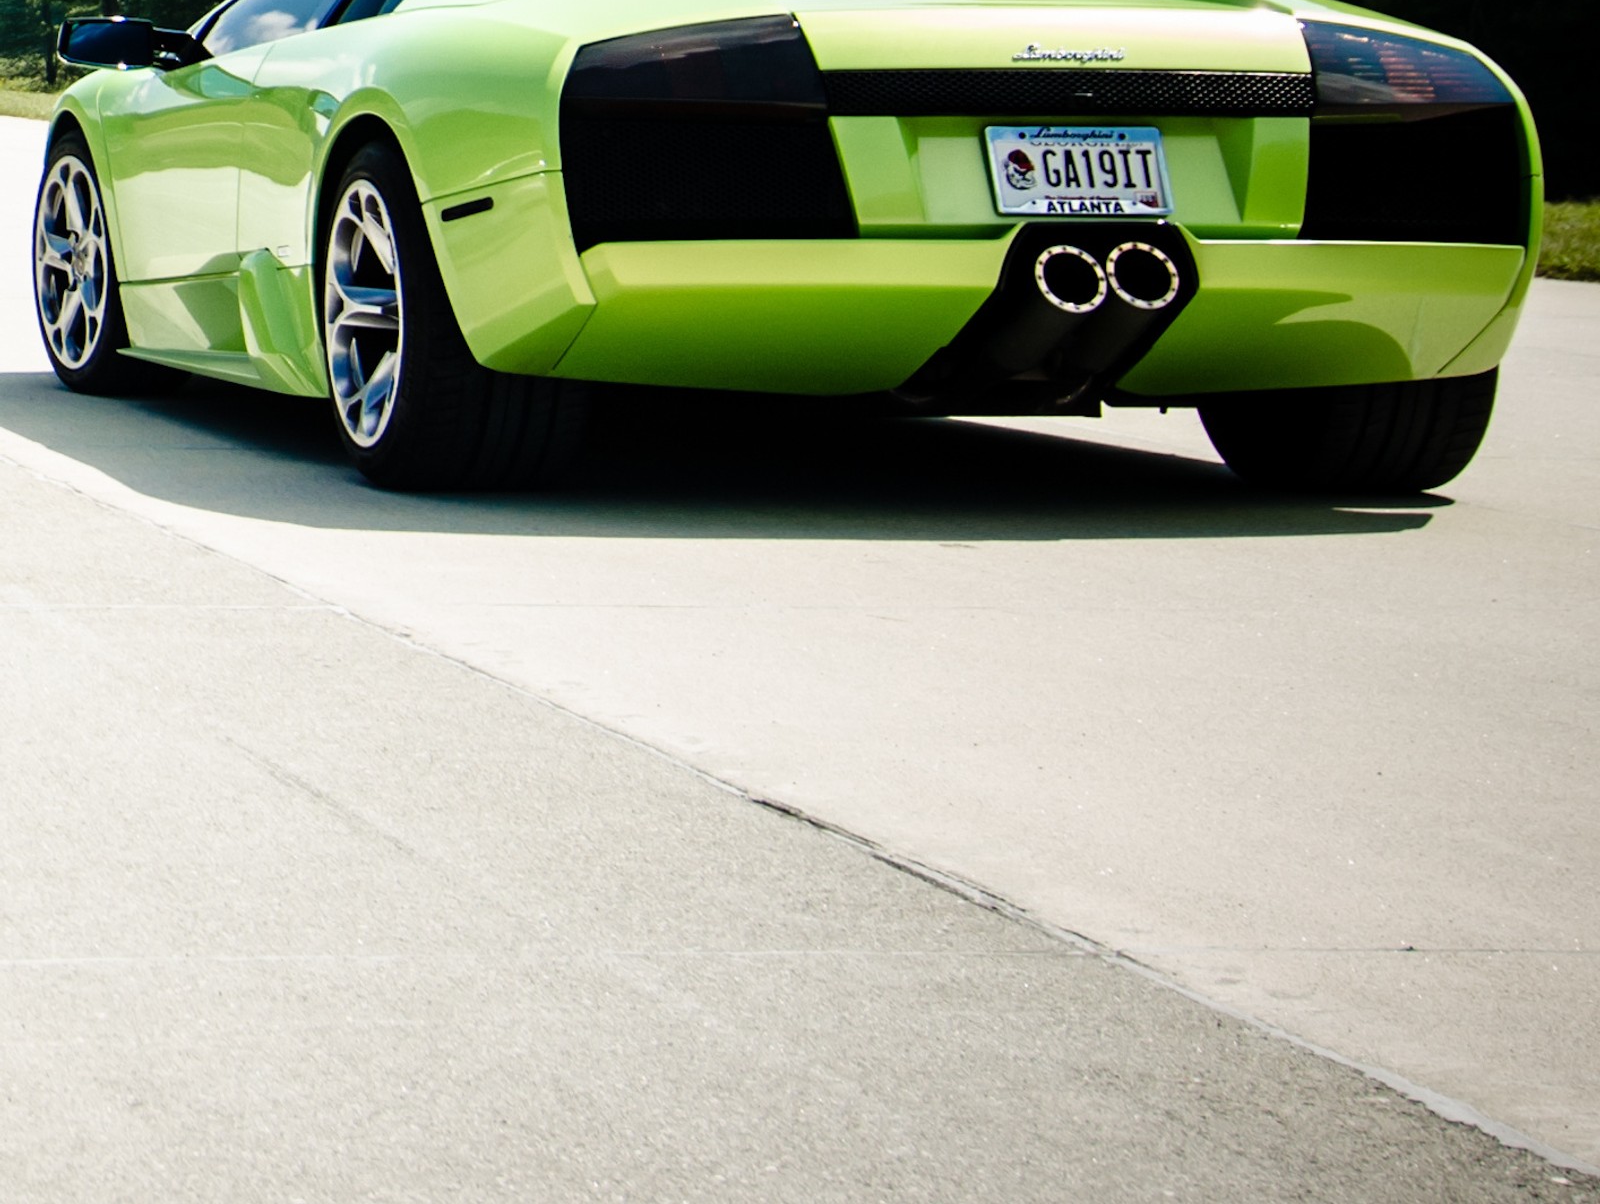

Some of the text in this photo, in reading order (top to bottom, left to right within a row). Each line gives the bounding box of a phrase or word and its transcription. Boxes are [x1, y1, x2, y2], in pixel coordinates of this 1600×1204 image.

[1012, 42, 1125, 64] Lamborghini
[1029, 126, 1115, 141] Lamborghini
[1042, 149, 1153, 189] GA19IT
[1046, 200, 1125, 213] ATLANTA
